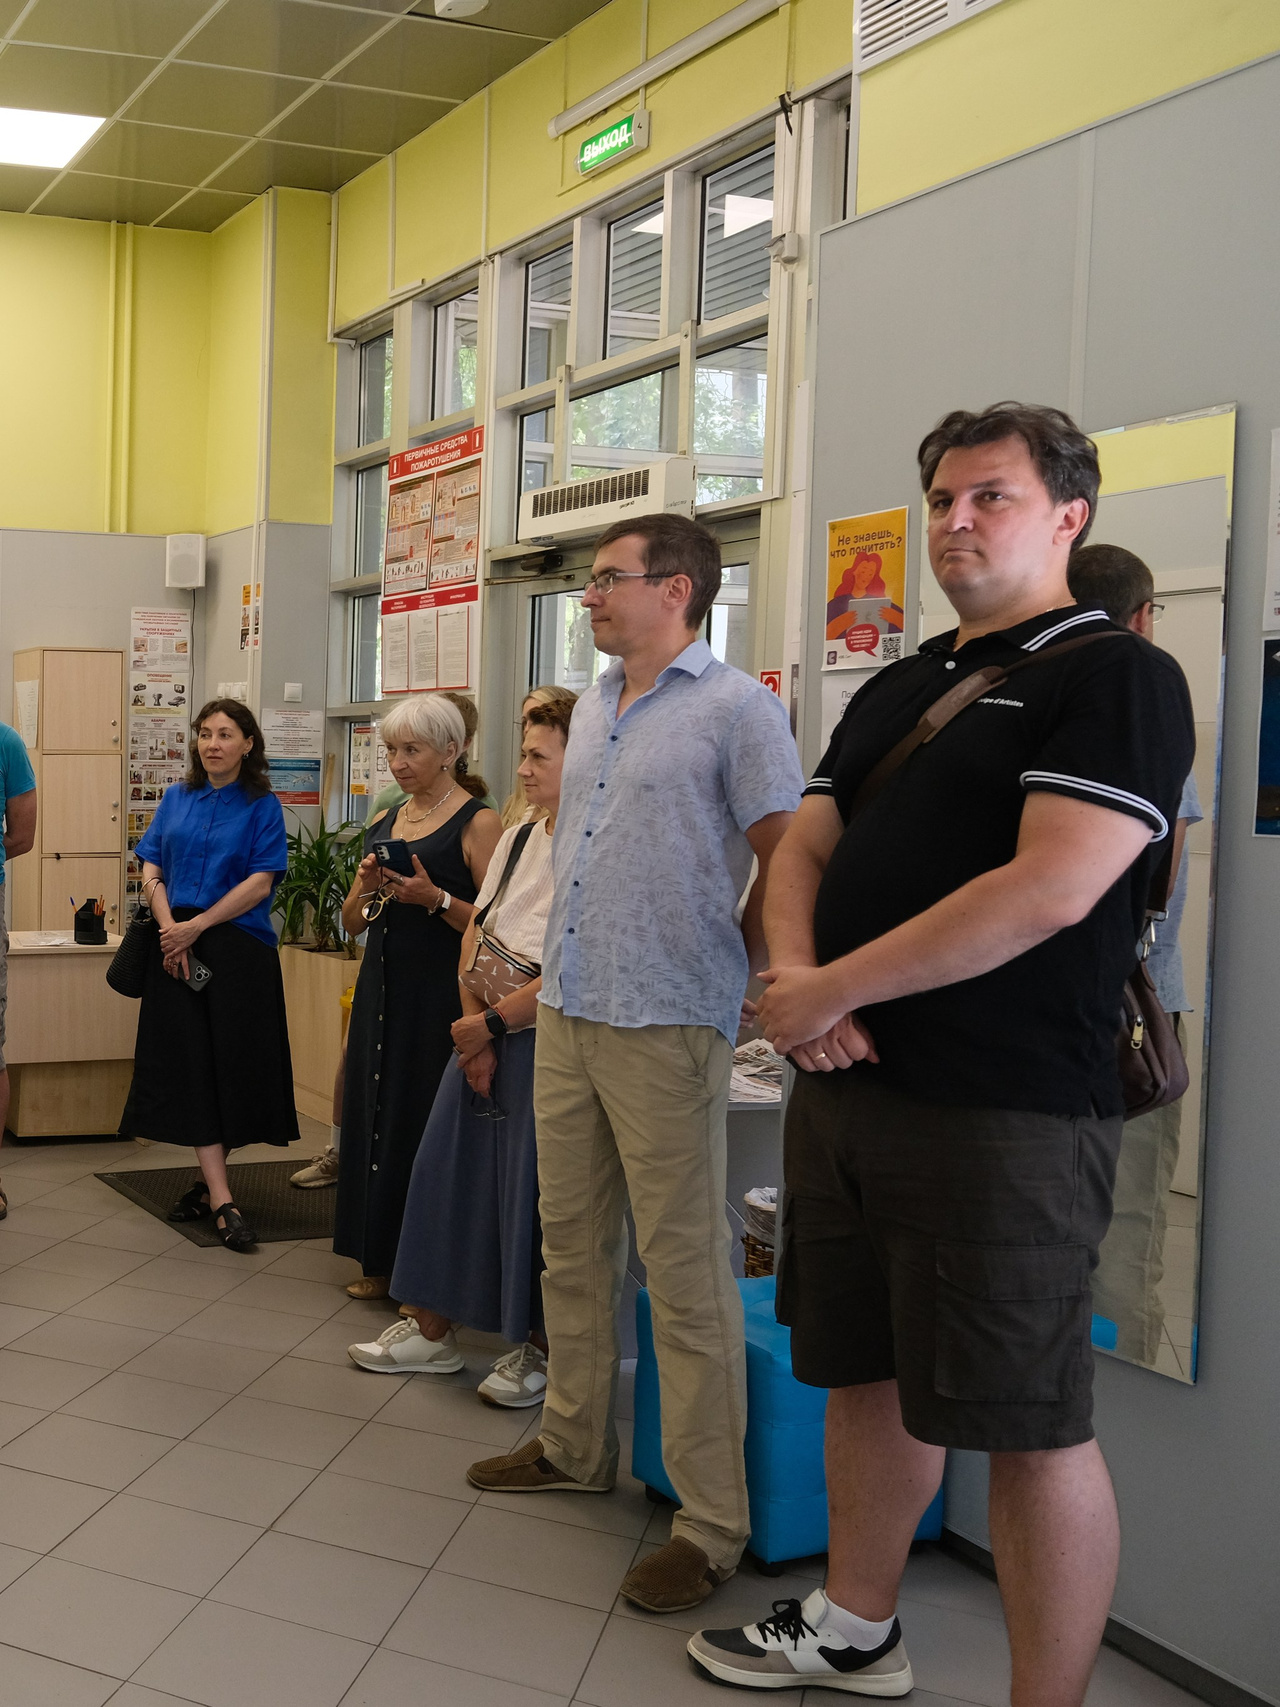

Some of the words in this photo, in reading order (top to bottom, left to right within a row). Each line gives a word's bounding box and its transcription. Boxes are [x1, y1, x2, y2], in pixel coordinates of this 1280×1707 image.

[583, 123, 631, 162] ВЫХОД
[404, 444, 440, 463] ПЕРВИЧНЫЕ
[440, 434, 469, 452] СРЕДСТВА
[410, 449, 461, 473] ПОЖАРОТУШЕНИЯ
[830, 548, 847, 558] что
[849, 536, 903, 556] почитать?
[837, 534, 851, 547] Не
[853, 529, 895, 544] знаешь,
